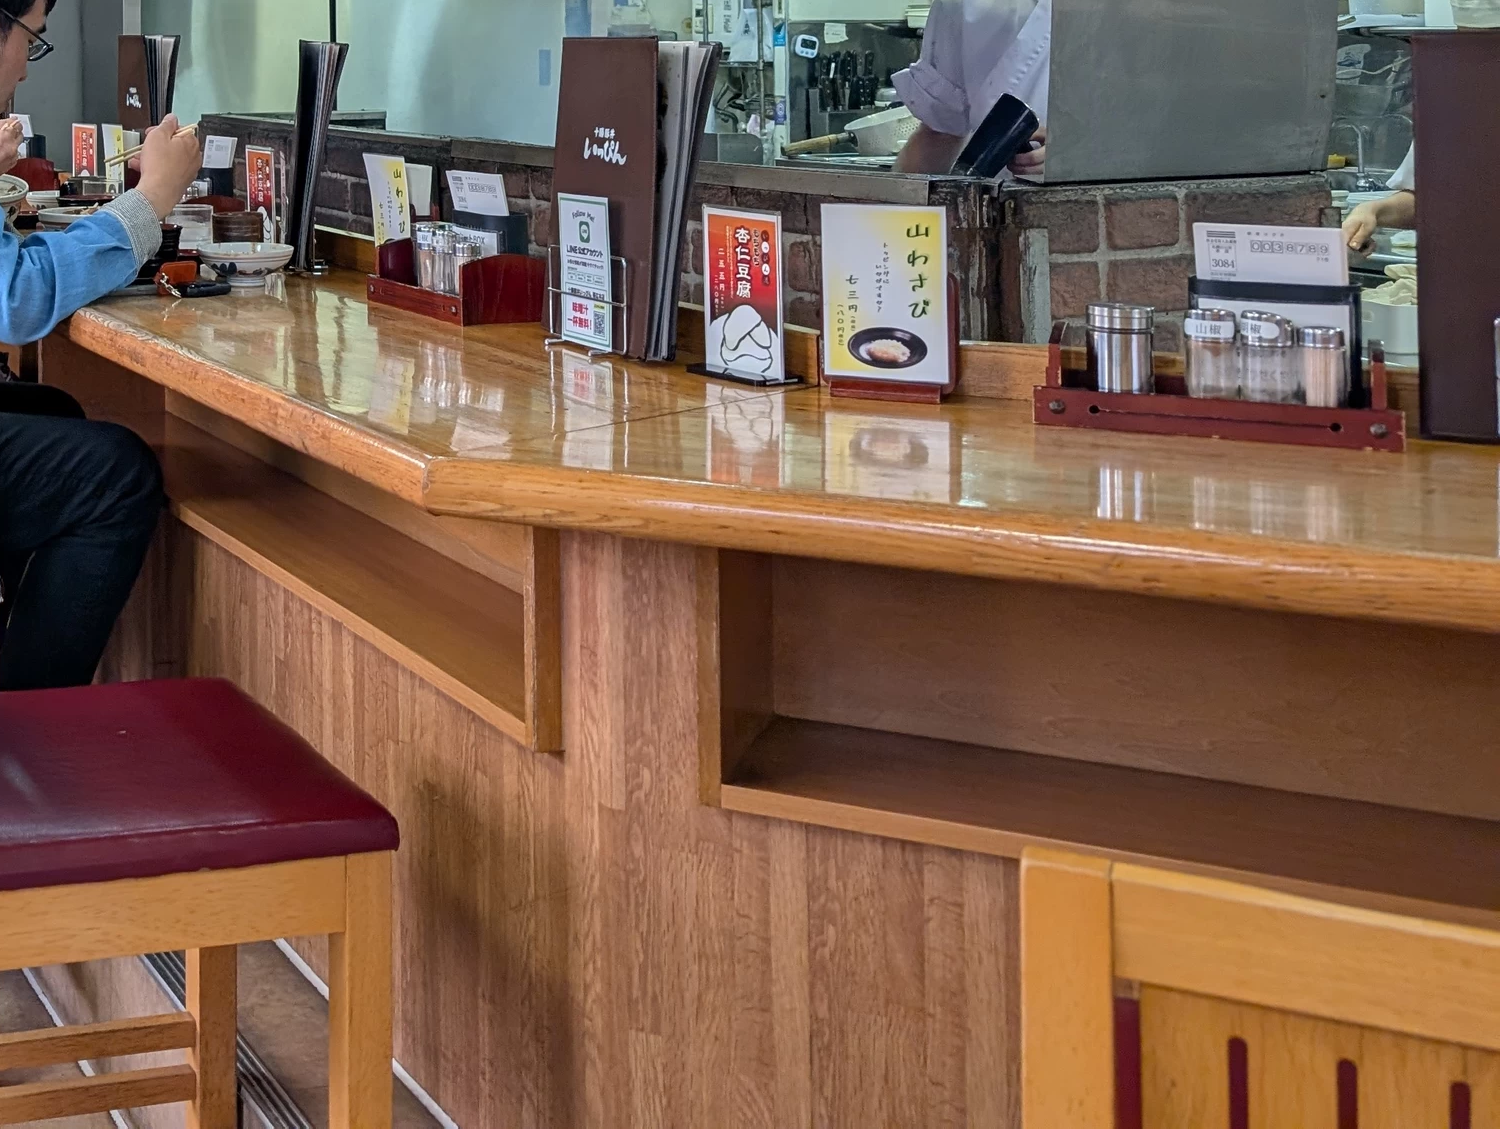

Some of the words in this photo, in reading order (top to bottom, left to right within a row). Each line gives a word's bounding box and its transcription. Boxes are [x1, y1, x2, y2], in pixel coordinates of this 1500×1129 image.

[566, 244, 577, 254] LINE
[735, 227, 751, 298] 杏仁豆腐
[906, 224, 930, 319] 山わさび
[1212, 258, 1235, 268] 3084
[845, 274, 859, 313] 七三円
[1196, 323, 1221, 335] 山椒
